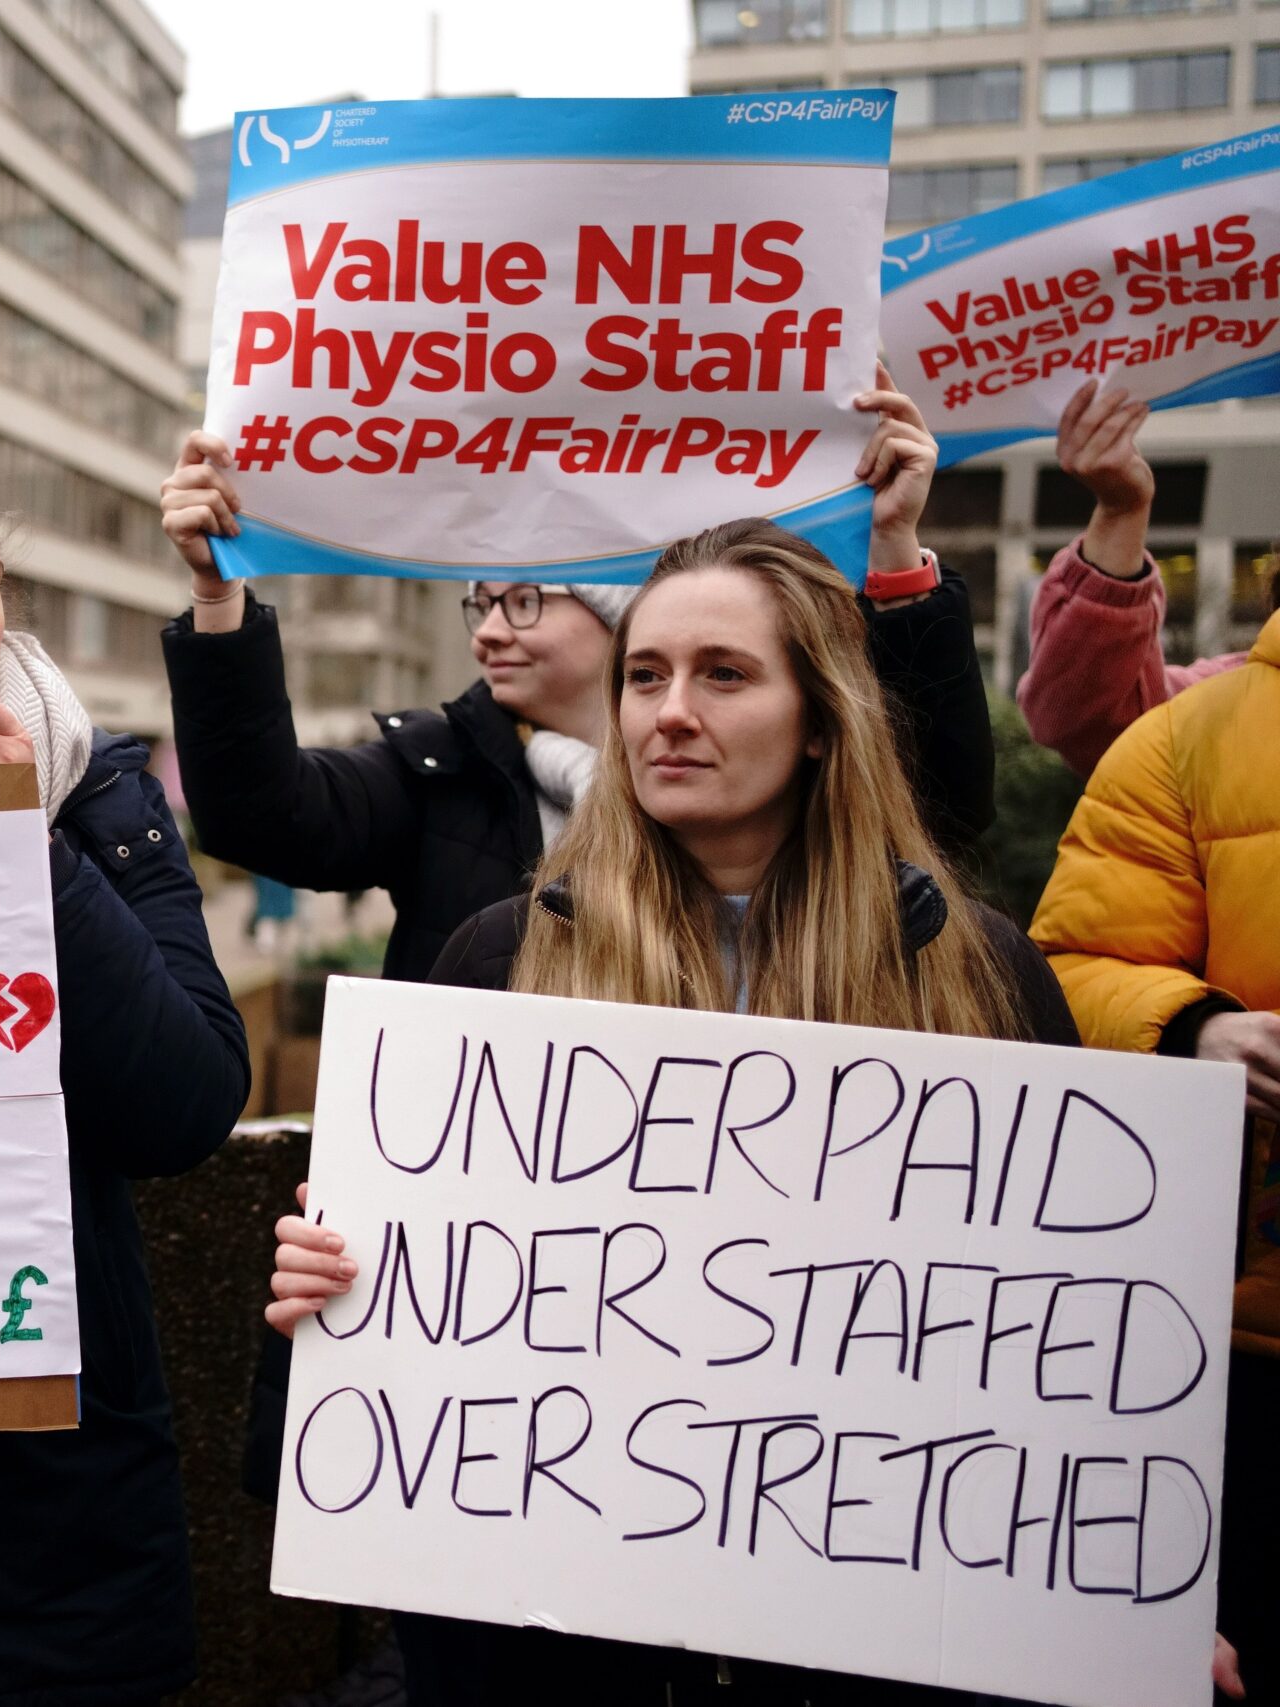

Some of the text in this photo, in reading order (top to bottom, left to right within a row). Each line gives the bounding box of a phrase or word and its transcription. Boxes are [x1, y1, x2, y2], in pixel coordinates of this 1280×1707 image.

[331, 136, 390, 148] PHYSIOTHERAPY
[332, 128, 344, 138] OF
[333, 118, 366, 128] SOCIETY
[335, 107, 377, 118] CHARTERED
[726, 97, 889, 124] #CSP4FairPay
[282, 218, 805, 306] Value NHS
[924, 215, 1256, 336] Value NHS
[917, 253, 1280, 380] Physio Staff
[232, 306, 843, 408] Physio Staff
[943, 315, 1279, 411] #CSP4FairPay
[232, 413, 821, 489] #CSP4FairPay
